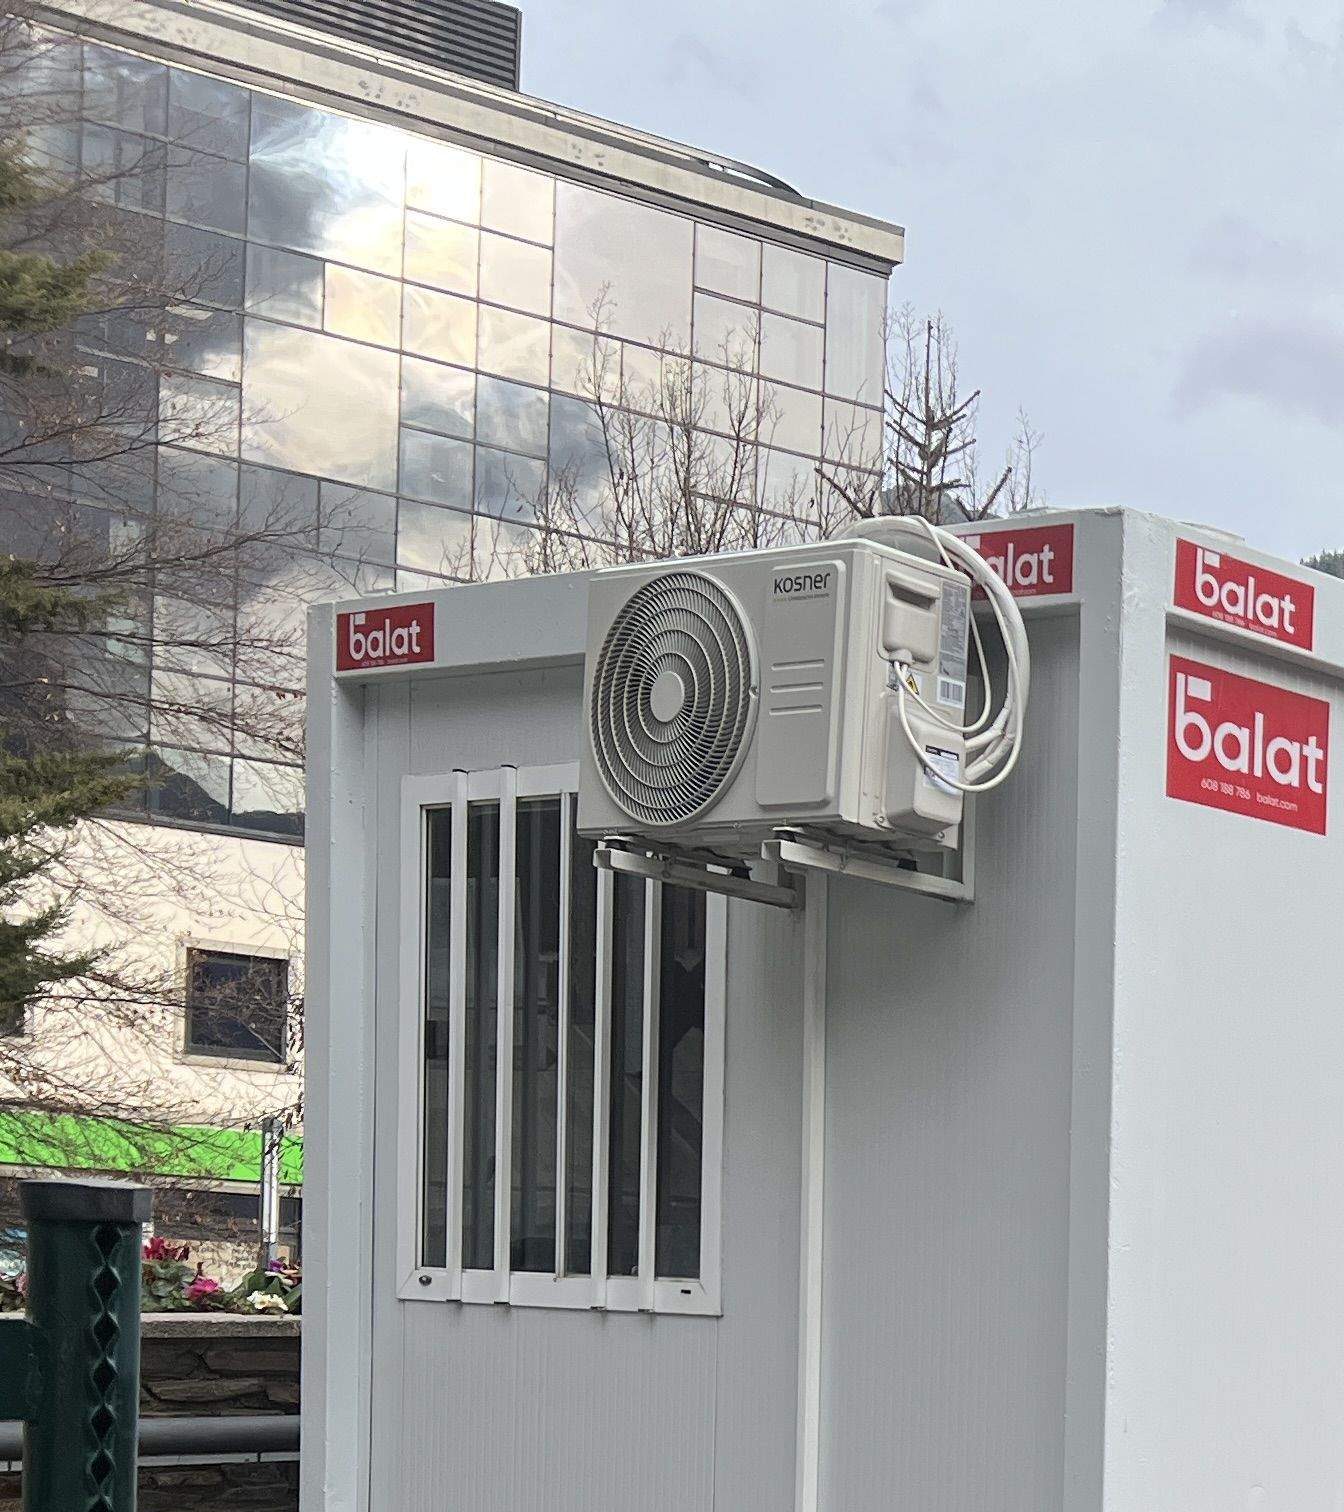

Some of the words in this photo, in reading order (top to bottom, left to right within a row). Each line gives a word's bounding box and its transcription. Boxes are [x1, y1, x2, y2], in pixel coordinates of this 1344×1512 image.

[1195, 547, 1296, 634] balat
[349, 612, 421, 661] balat
[1175, 672, 1324, 794] balat
